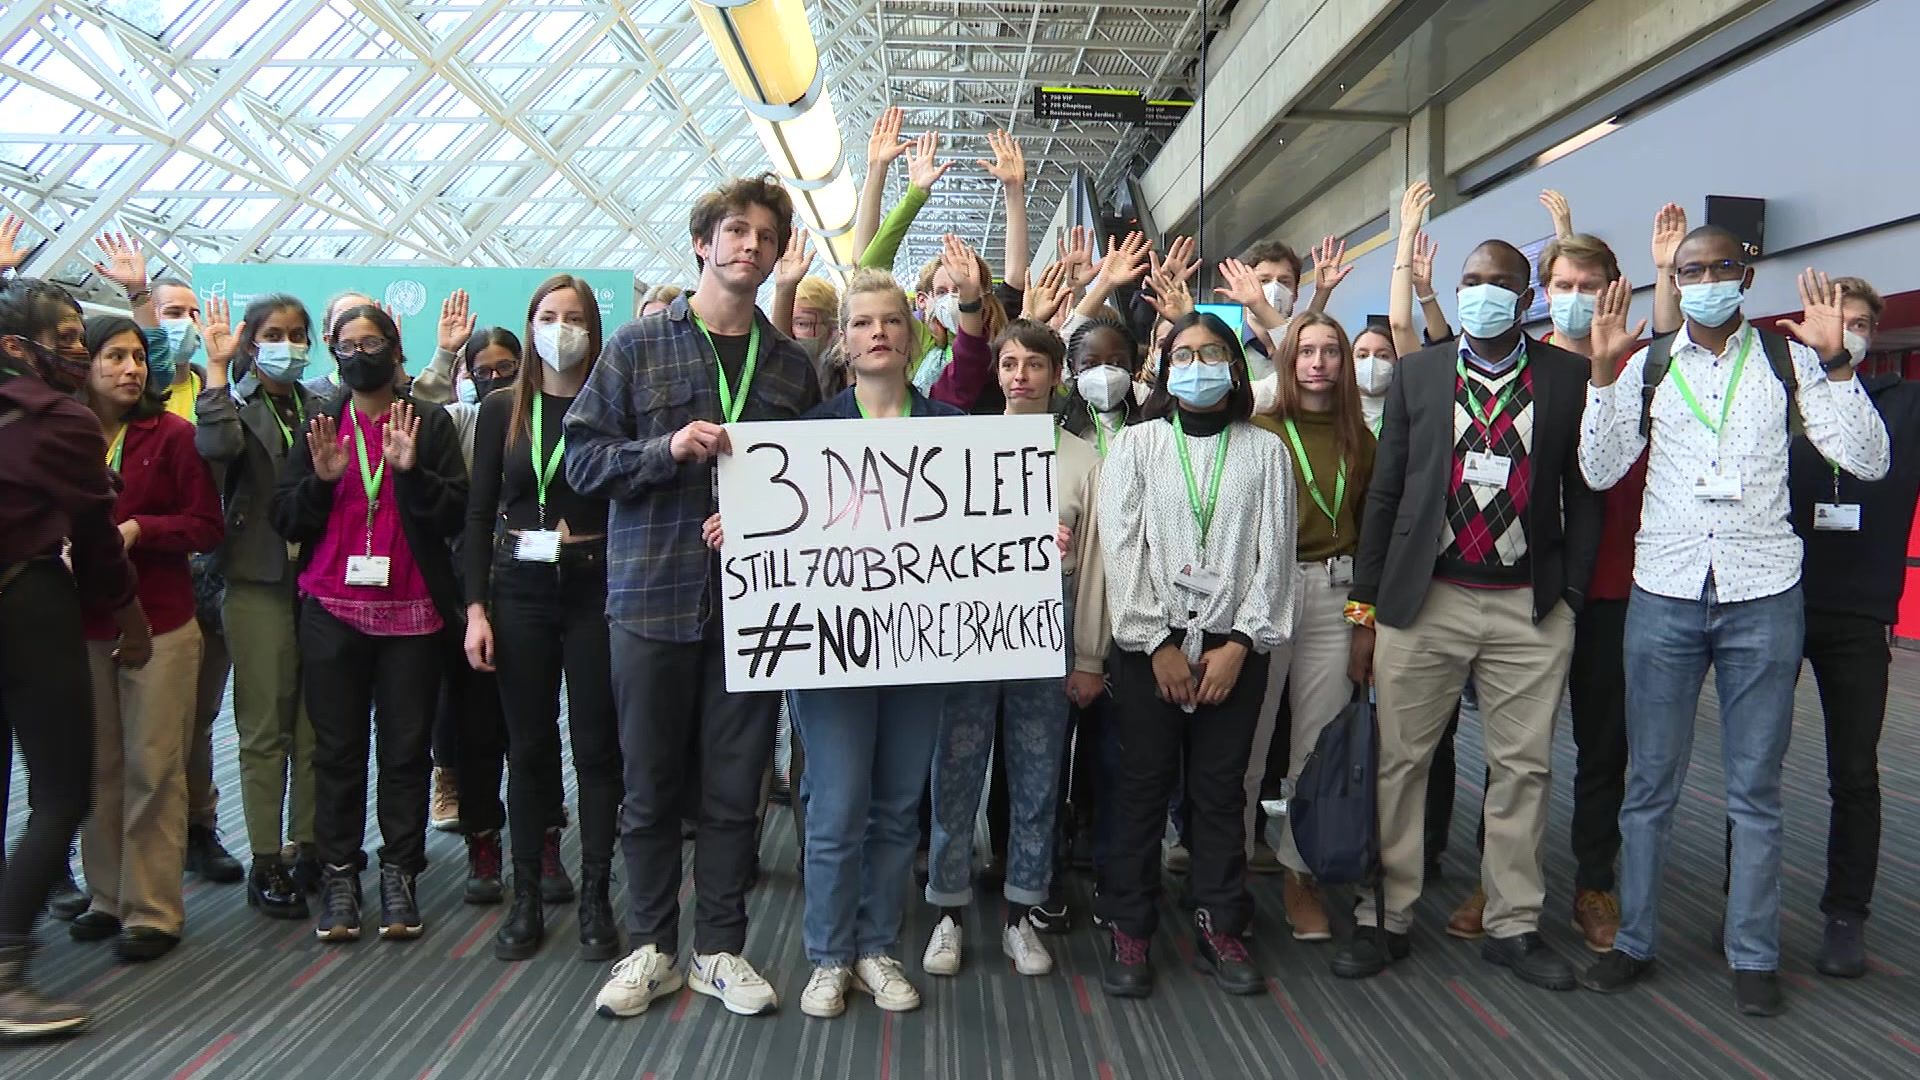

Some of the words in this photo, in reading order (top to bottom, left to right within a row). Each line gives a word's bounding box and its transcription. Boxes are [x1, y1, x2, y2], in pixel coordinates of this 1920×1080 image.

[743, 443, 808, 539] 3
[821, 446, 948, 531] DAYS
[964, 446, 1056, 516] LEFT
